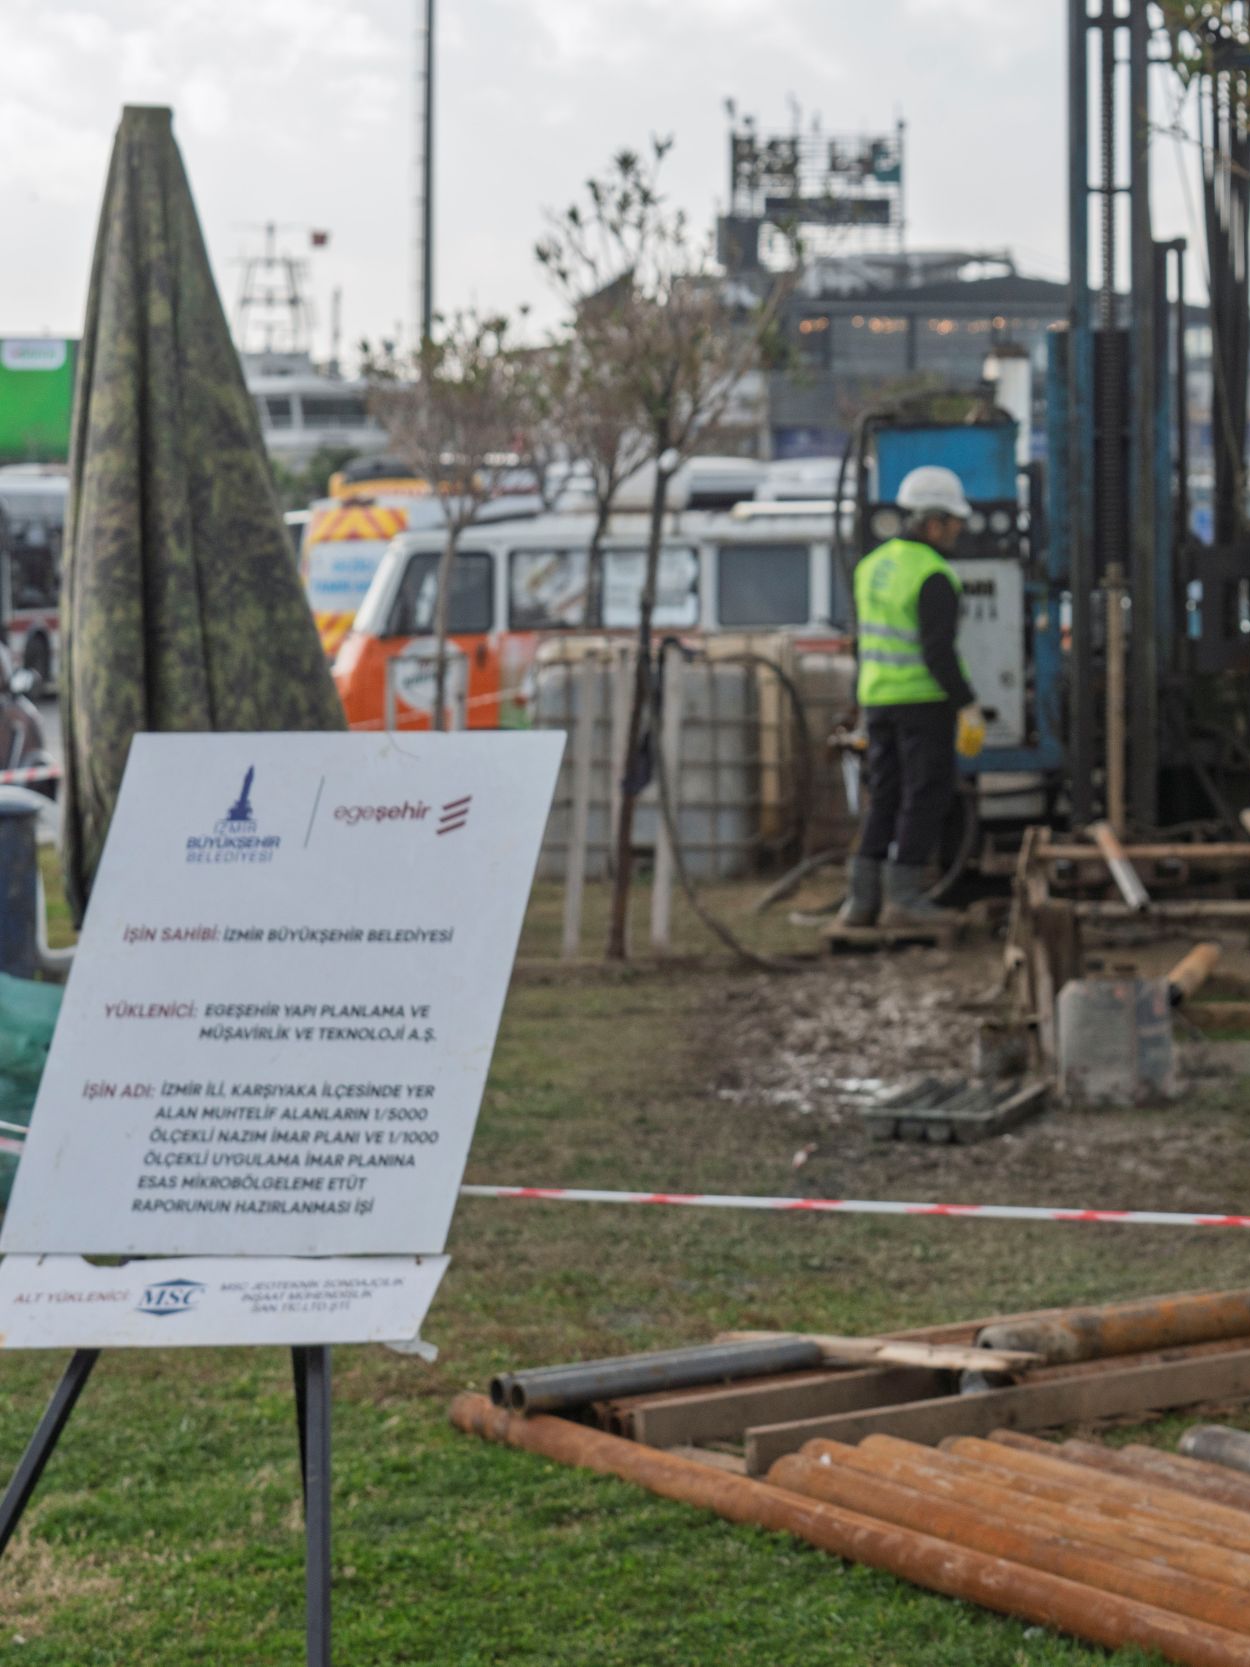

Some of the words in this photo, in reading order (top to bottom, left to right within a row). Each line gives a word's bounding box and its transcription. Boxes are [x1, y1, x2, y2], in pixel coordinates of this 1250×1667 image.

[333, 802, 431, 825] egeşehir
[186, 836, 281, 850] BÜYÜKŞEHİR
[186, 850, 273, 863] BELEDİYESİ
[123, 924, 156, 943] İŞİN
[161, 924, 220, 942] SAHİBİ:
[223, 925, 265, 943] İZMİR
[267, 927, 364, 944] BÜYÜKŞEHİR
[367, 926, 455, 943] BELEDİYESİ
[104, 1001, 199, 1019] YÜKLENİCİ:
[204, 1002, 281, 1020] EGEŞEHİR
[284, 1004, 317, 1018] YAPI
[320, 1004, 406, 1019] PLANLAMA
[411, 1004, 431, 1018] VE
[199, 1024, 290, 1043] MÜŞAVİRLİK
[296, 1027, 314, 1041] VE
[319, 1025, 406, 1042] TEKNOLOJİ
[82, 1080, 117, 1100] İŞİN
[161, 1080, 203, 1097] İZMİR
[231, 1084, 317, 1100] KARŞIYAKA
[321, 1081, 402, 1100] İLÇESİNDE
[406, 1085, 436, 1098] YER
[155, 1106, 198, 1120] ALAN
[201, 1104, 278, 1120] MUHTELİF
[281, 1107, 370, 1121] ALANLARIN
[374, 1107, 429, 1121] 1/5000
[149, 1126, 215, 1144] ÖLÇEKLİ
[217, 1129, 267, 1143] NAZIM
[270, 1127, 310, 1143] İMAR
[314, 1130, 361, 1144] PLANI
[364, 1130, 385, 1144] VE
[388, 1130, 440, 1144] 1/1000
[143, 1149, 210, 1168] ÖLÇEKLİ
[212, 1152, 300, 1167] UYGULAMA
[304, 1150, 345, 1167] İMAR
[347, 1153, 416, 1167] PLANINA
[137, 1175, 178, 1189] ESAS
[181, 1174, 325, 1191] MİKROBÖLGELEME
[327, 1174, 368, 1191] ETÜT
[131, 1199, 231, 1213] RAPORUNUN
[234, 1200, 351, 1214] HAZIRLANMASI
[354, 1197, 376, 1216] İŞİ
[140, 1288, 206, 1306] MSC
